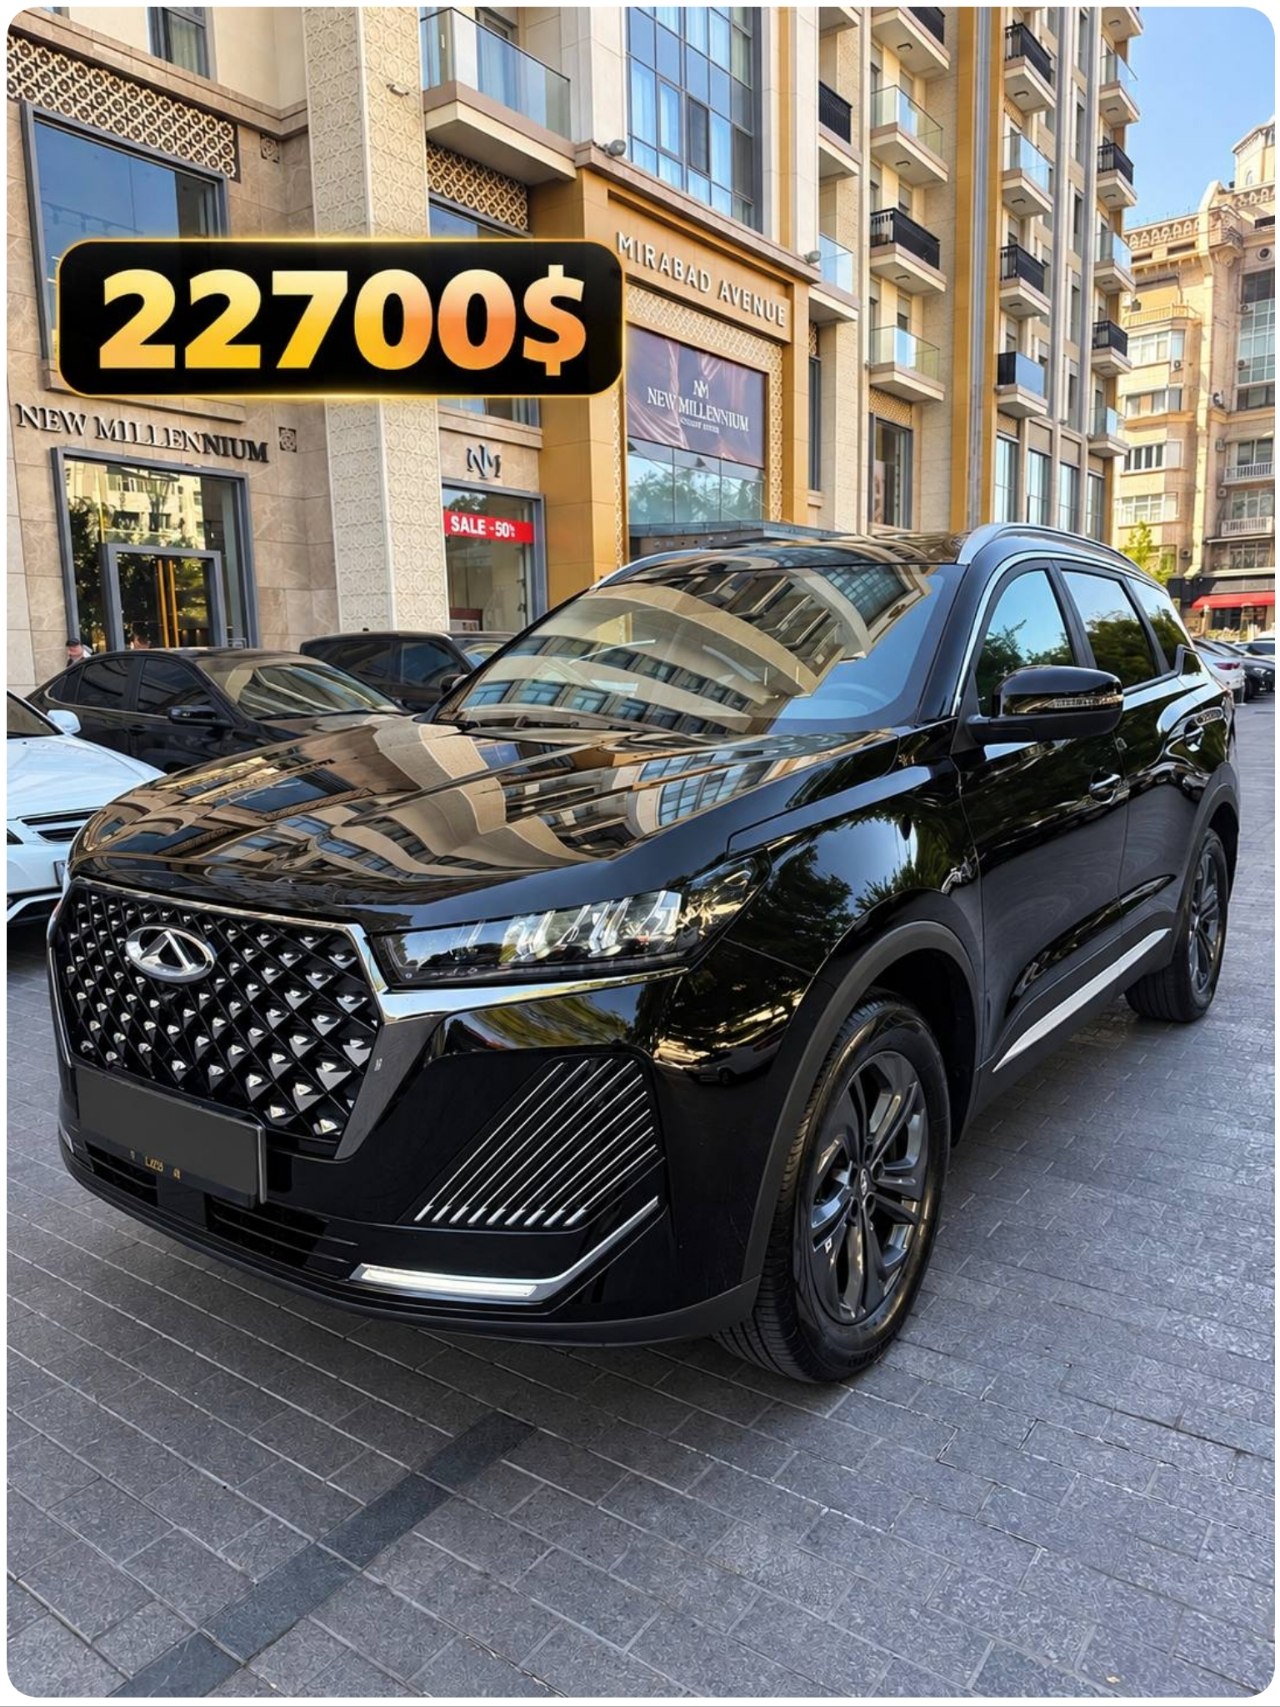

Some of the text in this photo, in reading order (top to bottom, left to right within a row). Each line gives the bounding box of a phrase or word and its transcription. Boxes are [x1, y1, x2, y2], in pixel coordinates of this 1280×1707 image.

[617, 231, 787, 328] MIRABAD AVENUE
[15, 402, 270, 464] NEW MILLENNIUM
[647, 386, 677, 411] NEW
[678, 395, 750, 433] MILLENNIUM
[450, 515, 487, 536] SALE
